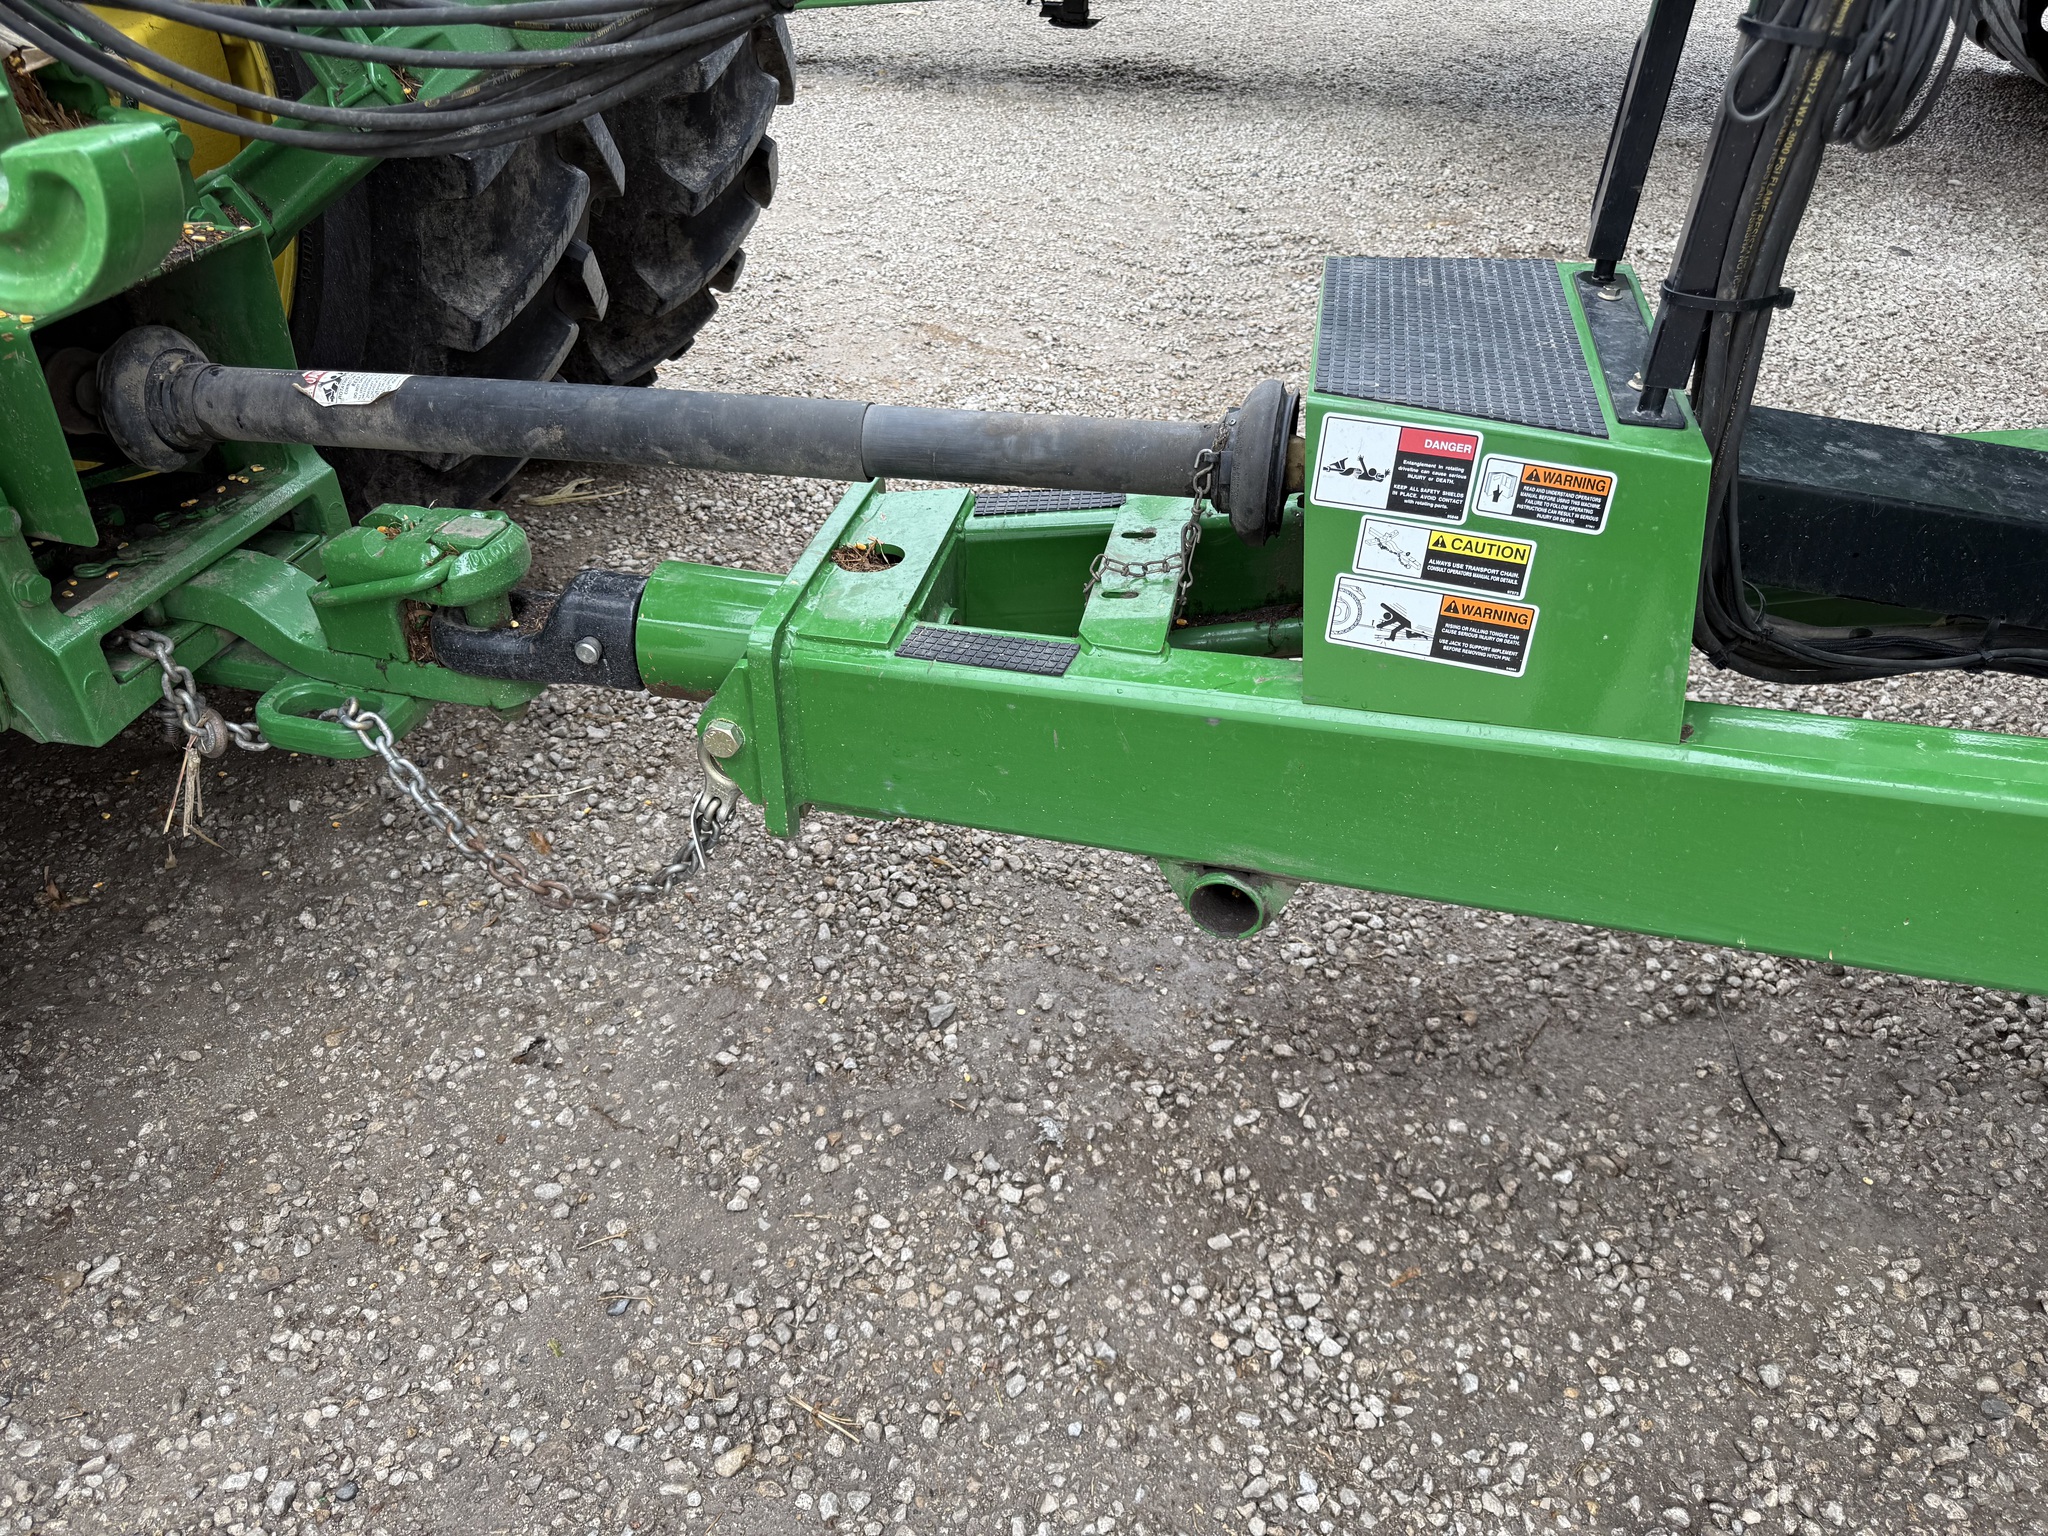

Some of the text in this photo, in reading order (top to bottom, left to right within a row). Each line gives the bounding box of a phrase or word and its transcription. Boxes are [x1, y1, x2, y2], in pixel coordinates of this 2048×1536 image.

[1781, 130, 1797, 155] 3000
[1775, 157, 1787, 175] PSI
[1762, 176, 1779, 212] FLAME
[1424, 439, 1472, 454] DANGER
[1403, 459, 1437, 469] Entanglement
[1407, 473, 1426, 481] INJURY
[1435, 477, 1454, 485] DEATH.
[1543, 471, 1606, 493] WARNING
[1400, 491, 1418, 499] PLACE.
[1438, 497, 1463, 505] CONTACT
[1420, 487, 1440, 495] SAFETY
[1442, 490, 1464, 498] SHIELDS
[1546, 488, 1575, 499] UNDERSTAND
[1575, 493, 1602, 503] OPERATORS
[1415, 500, 1434, 508] rotating
[1520, 491, 1538, 499] MANUAL
[1539, 494, 1556, 502] BEFORE
[1580, 501, 1601, 510] MACHINE.
[1524, 499, 1543, 507] FAILURE
[1550, 502, 1568, 511] FOLLOW
[1568, 505, 1594, 515] OPERATING
[1516, 504, 1547, 513] INSTRUCTIONS
[1558, 510, 1575, 518] RESULT
[1580, 514, 1599, 522] SERIOUS
[1559, 517, 1575, 525] DEATH.
[1451, 537, 1526, 561] CAUTION
[1427, 565, 1446, 573] CONSULT
[1447, 569, 1472, 578] OPERATORS
[1500, 577, 1519, 585] DETAILS.
[1428, 558, 1451, 568] ALWAYS
[1465, 564, 1499, 575] TRANSPORT
[1499, 570, 1519, 579] CHAIN.
[1461, 603, 1529, 625] WARNING
[1441, 628, 1457, 636] CAUSE
[1458, 631, 1478, 639] SERIOUS
[1479, 634, 1496, 642] INJURY
[1469, 627, 1488, 635] FALLING
[1489, 630, 1508, 638] TONGUE
[1443, 645, 1462, 653] BEFORE
[1462, 648, 1487, 657] REMOVING
[1469, 642, 1491, 652] SUPPORT
[1491, 647, 1519, 657] IMPLEMENT
